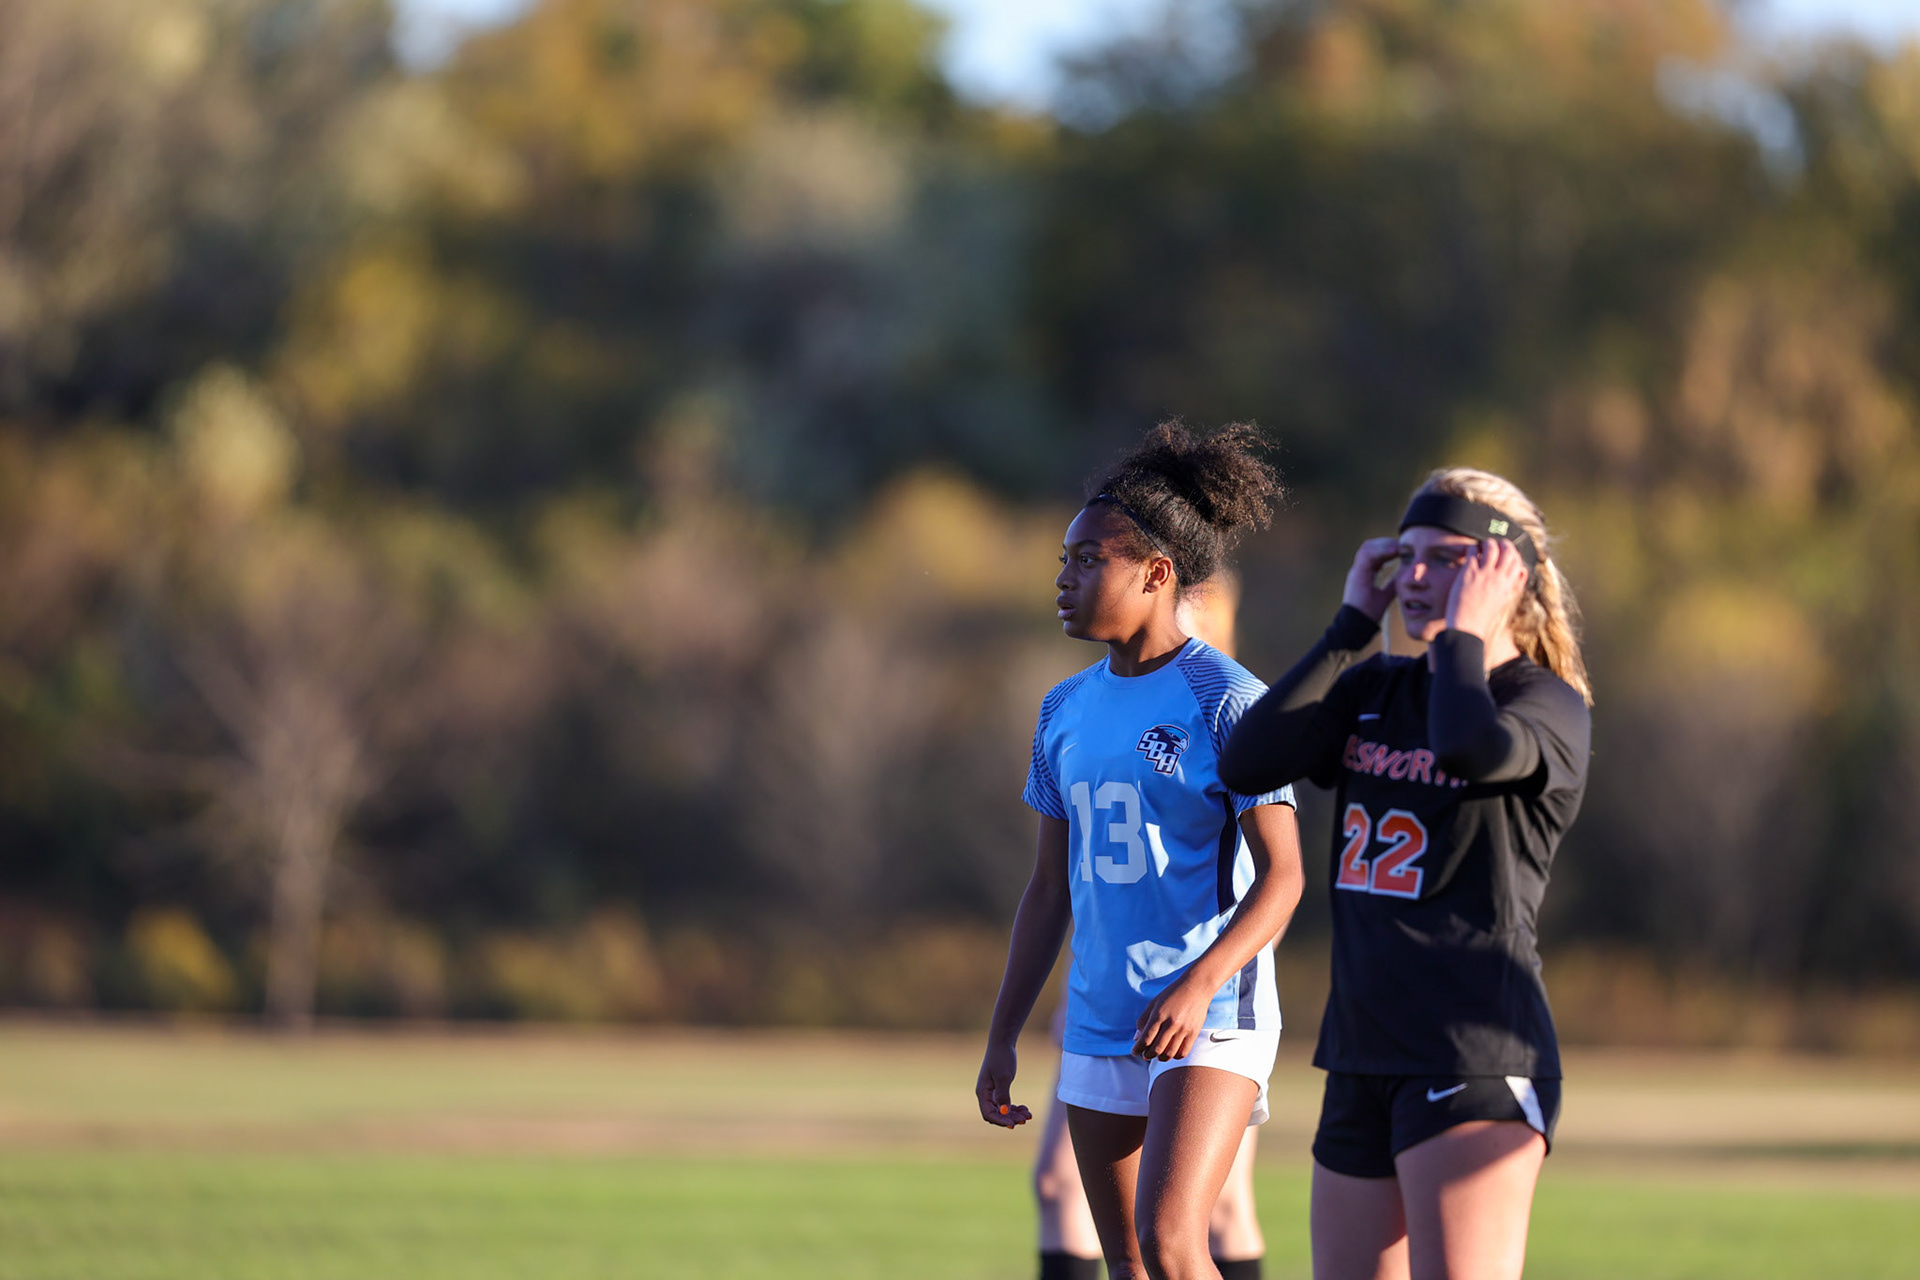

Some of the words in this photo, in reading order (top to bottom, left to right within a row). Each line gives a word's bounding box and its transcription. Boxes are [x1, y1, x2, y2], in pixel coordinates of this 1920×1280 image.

[1138, 731, 1178, 772] SBA
[1070, 781, 1148, 884] 13
[1335, 803, 1428, 900] 22
